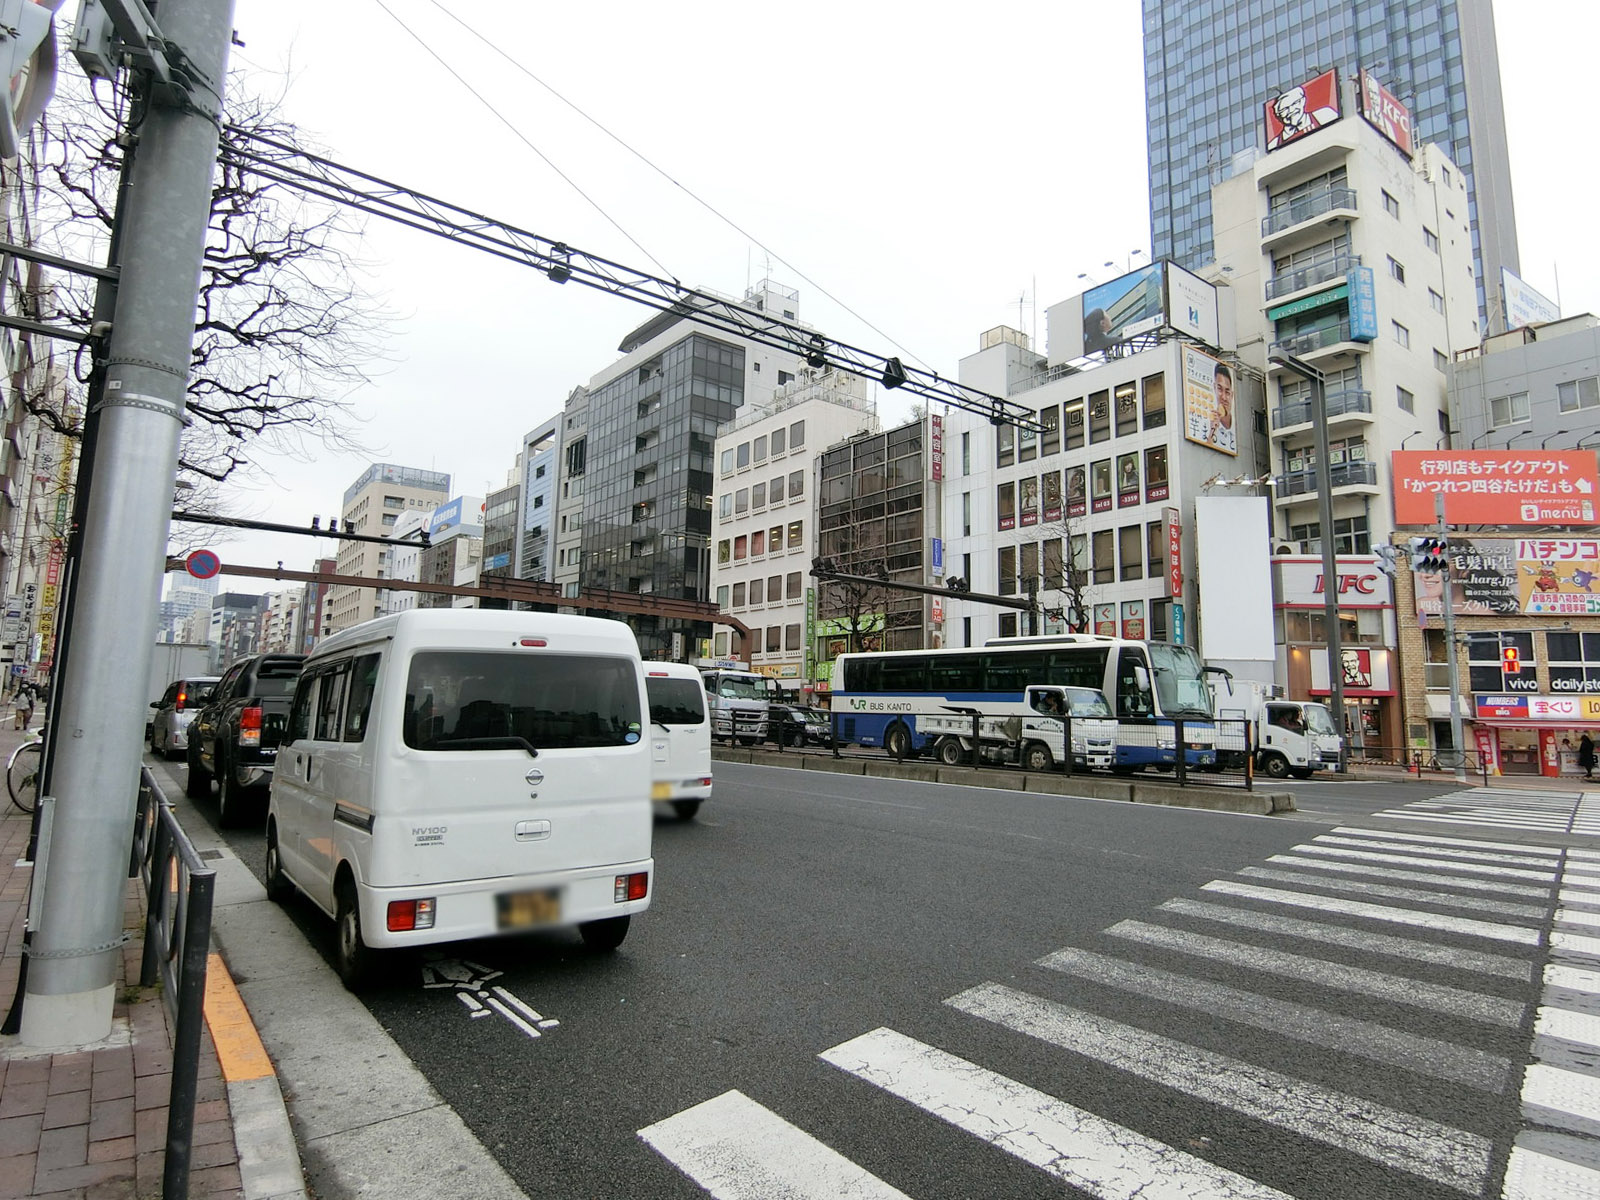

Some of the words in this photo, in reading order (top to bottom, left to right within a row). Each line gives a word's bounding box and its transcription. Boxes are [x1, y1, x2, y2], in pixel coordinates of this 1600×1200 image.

[1383, 99, 1409, 133] KFC
[933, 426, 942, 463] 美容室
[1420, 460, 1569, 475] 行列店もテイクアウト
[1403, 478, 1573, 494] 「かつれつ四谷たけだ」も
[1540, 509, 1580, 519] menu
[1519, 541, 1598, 559] パチンコ
[1508, 679, 1537, 689] vivo
[854, 700, 867, 710] JR
[887, 703, 911, 711] KANTO
[1534, 701, 1573, 713] 宝くじ
[412, 827, 448, 835] NV100
